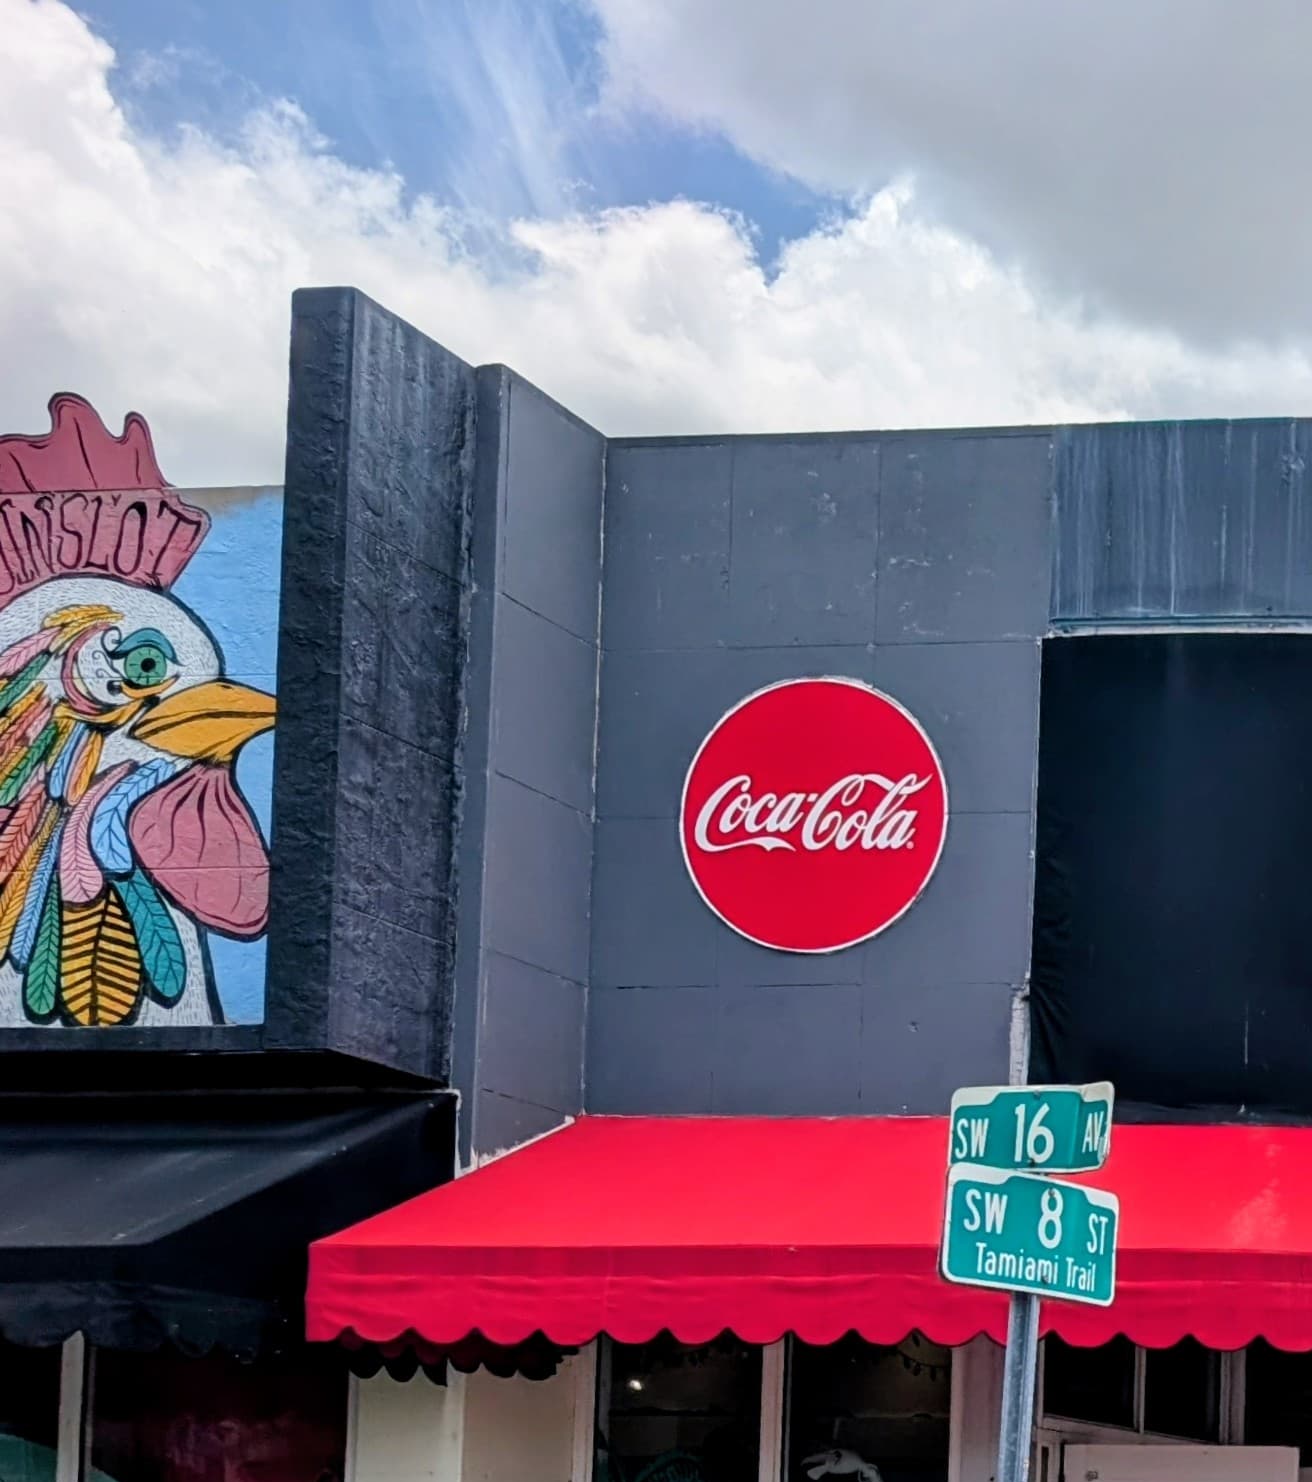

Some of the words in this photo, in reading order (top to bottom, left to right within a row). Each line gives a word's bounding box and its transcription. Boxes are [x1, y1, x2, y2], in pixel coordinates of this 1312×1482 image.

[694, 772, 934, 852] Coca-Cola
[954, 1118, 989, 1159] SW
[1014, 1102, 1054, 1163] 16
[963, 1188, 1008, 1235] SW
[1038, 1188, 1064, 1249] 8
[1087, 1213, 1108, 1255] ST
[975, 1242, 1059, 1285] Tamiami
[1065, 1257, 1096, 1292] Trail
